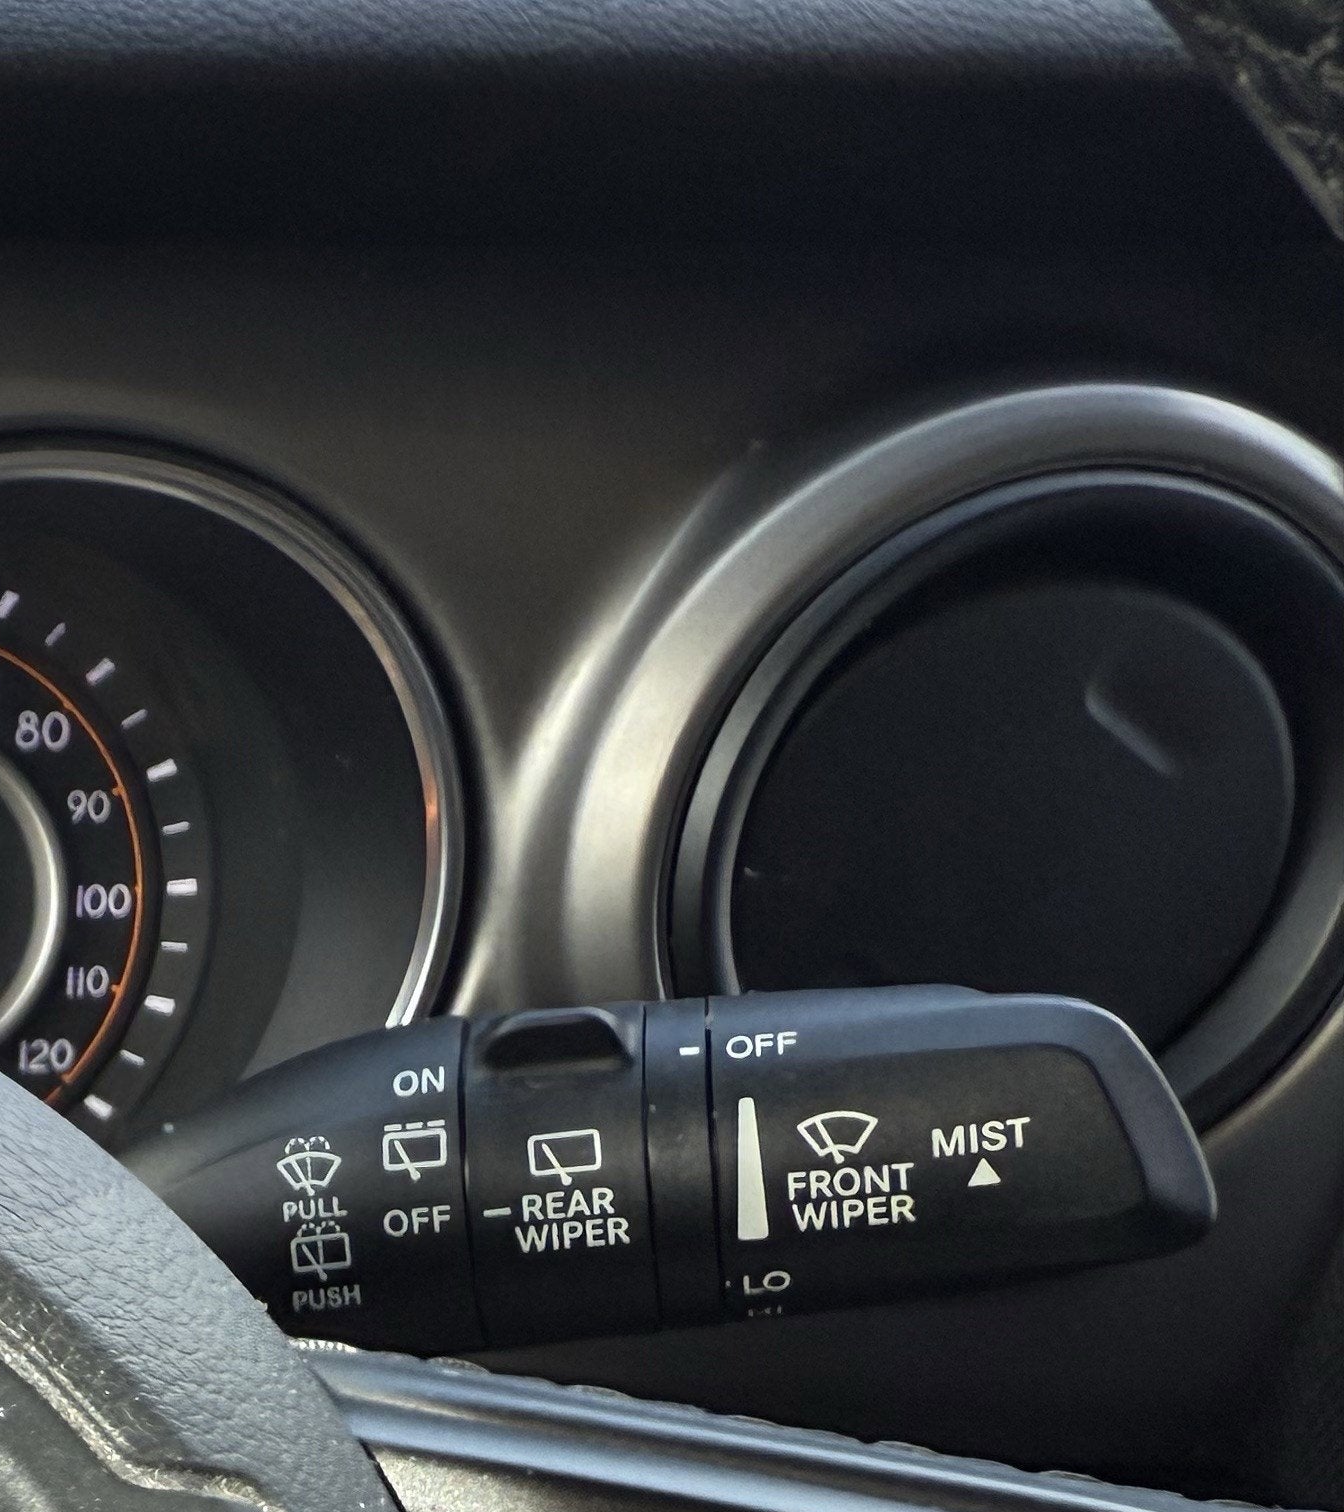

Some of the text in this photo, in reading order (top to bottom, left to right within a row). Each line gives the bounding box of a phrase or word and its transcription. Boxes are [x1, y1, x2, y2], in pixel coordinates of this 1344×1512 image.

[15, 711, 71, 752] 80
[67, 790, 111, 824] 90
[75, 883, 132, 919] 100
[66, 965, 110, 999] 110
[19, 1039, 73, 1075] 120
[726, 1031, 797, 1058] OFF
[393, 1067, 445, 1098] ON
[931, 1117, 1030, 1158] MIST
[788, 1162, 914, 1201] FRONT
[283, 1196, 348, 1221] PULL
[383, 1205, 451, 1238] OFF
[523, 1187, 615, 1222] REAR
[792, 1195, 916, 1232] WIPER
[516, 1218, 630, 1253] WIPER
[292, 1285, 361, 1312] PUSH
[743, 1270, 791, 1295] LO
